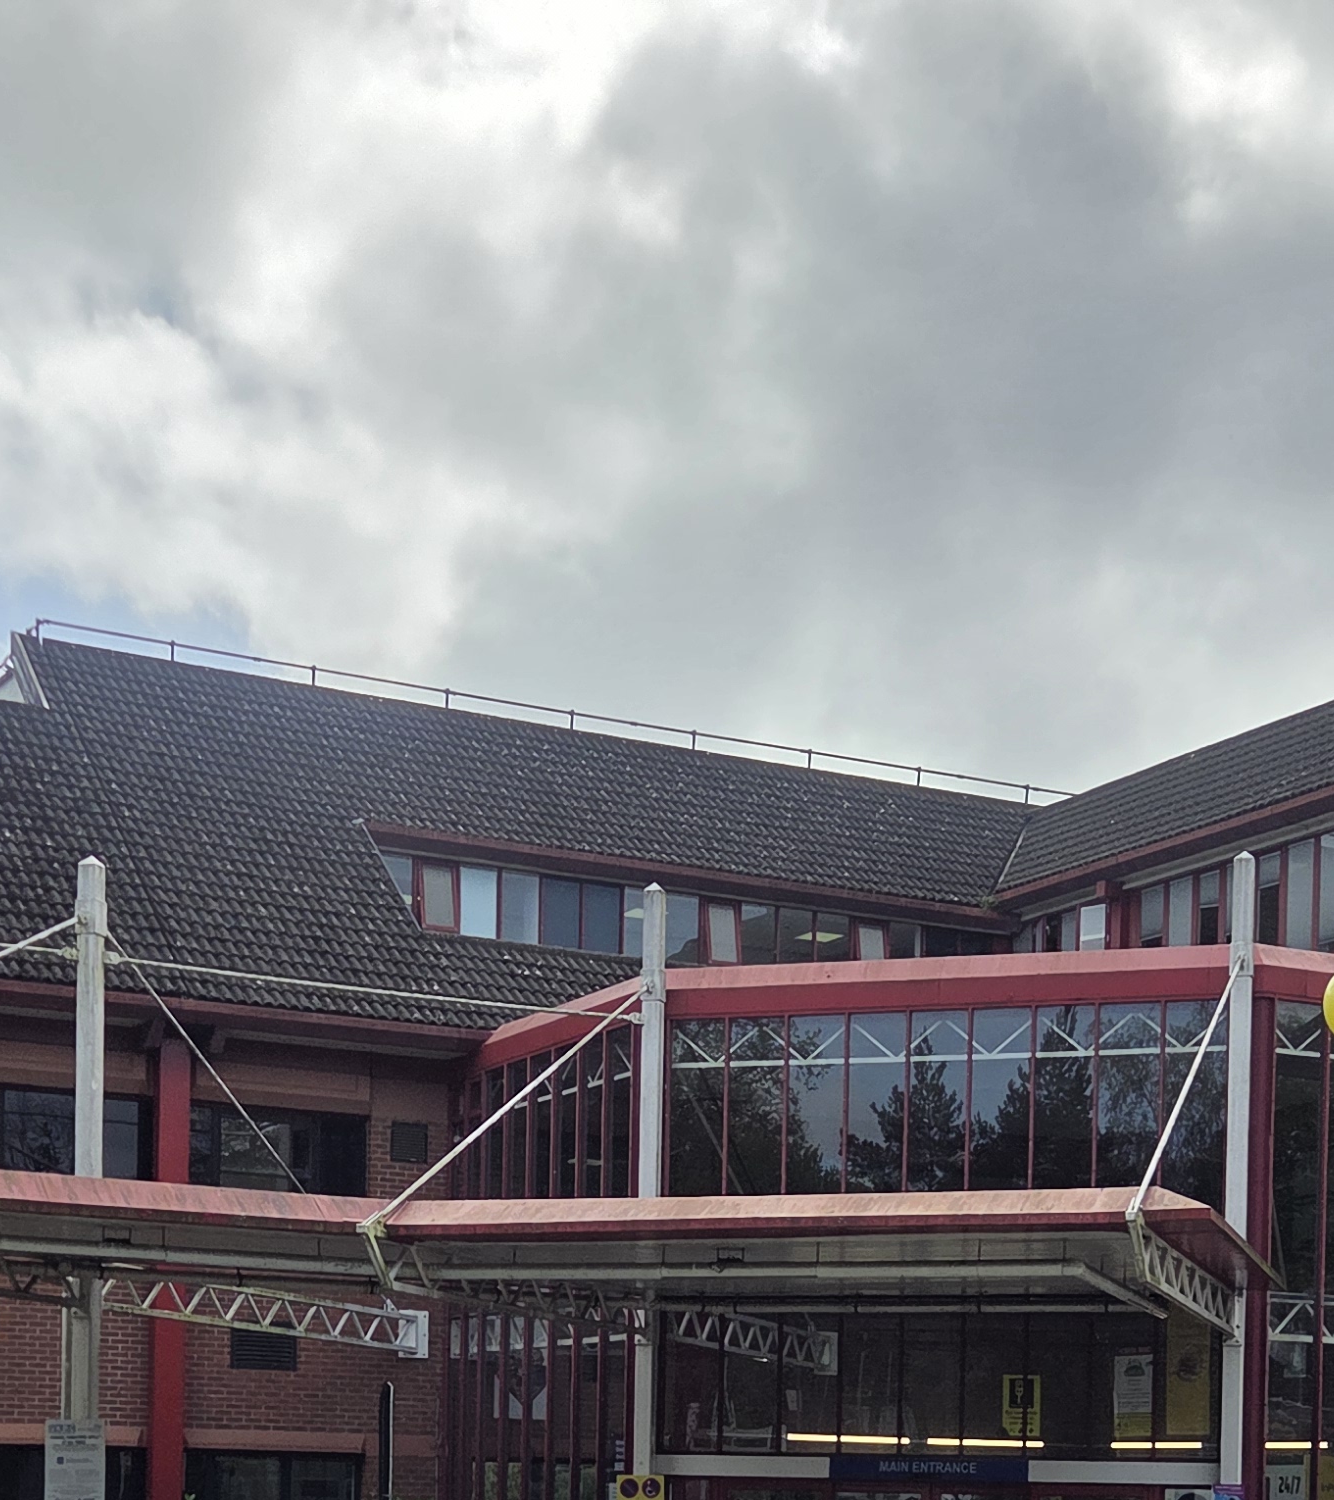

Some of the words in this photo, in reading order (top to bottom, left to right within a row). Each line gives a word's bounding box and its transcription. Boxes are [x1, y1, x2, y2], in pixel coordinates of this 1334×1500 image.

[879, 1461, 909, 1473] MAIN
[912, 1461, 978, 1474] ENTRANCE
[1278, 1476, 1301, 1495] 24/7
